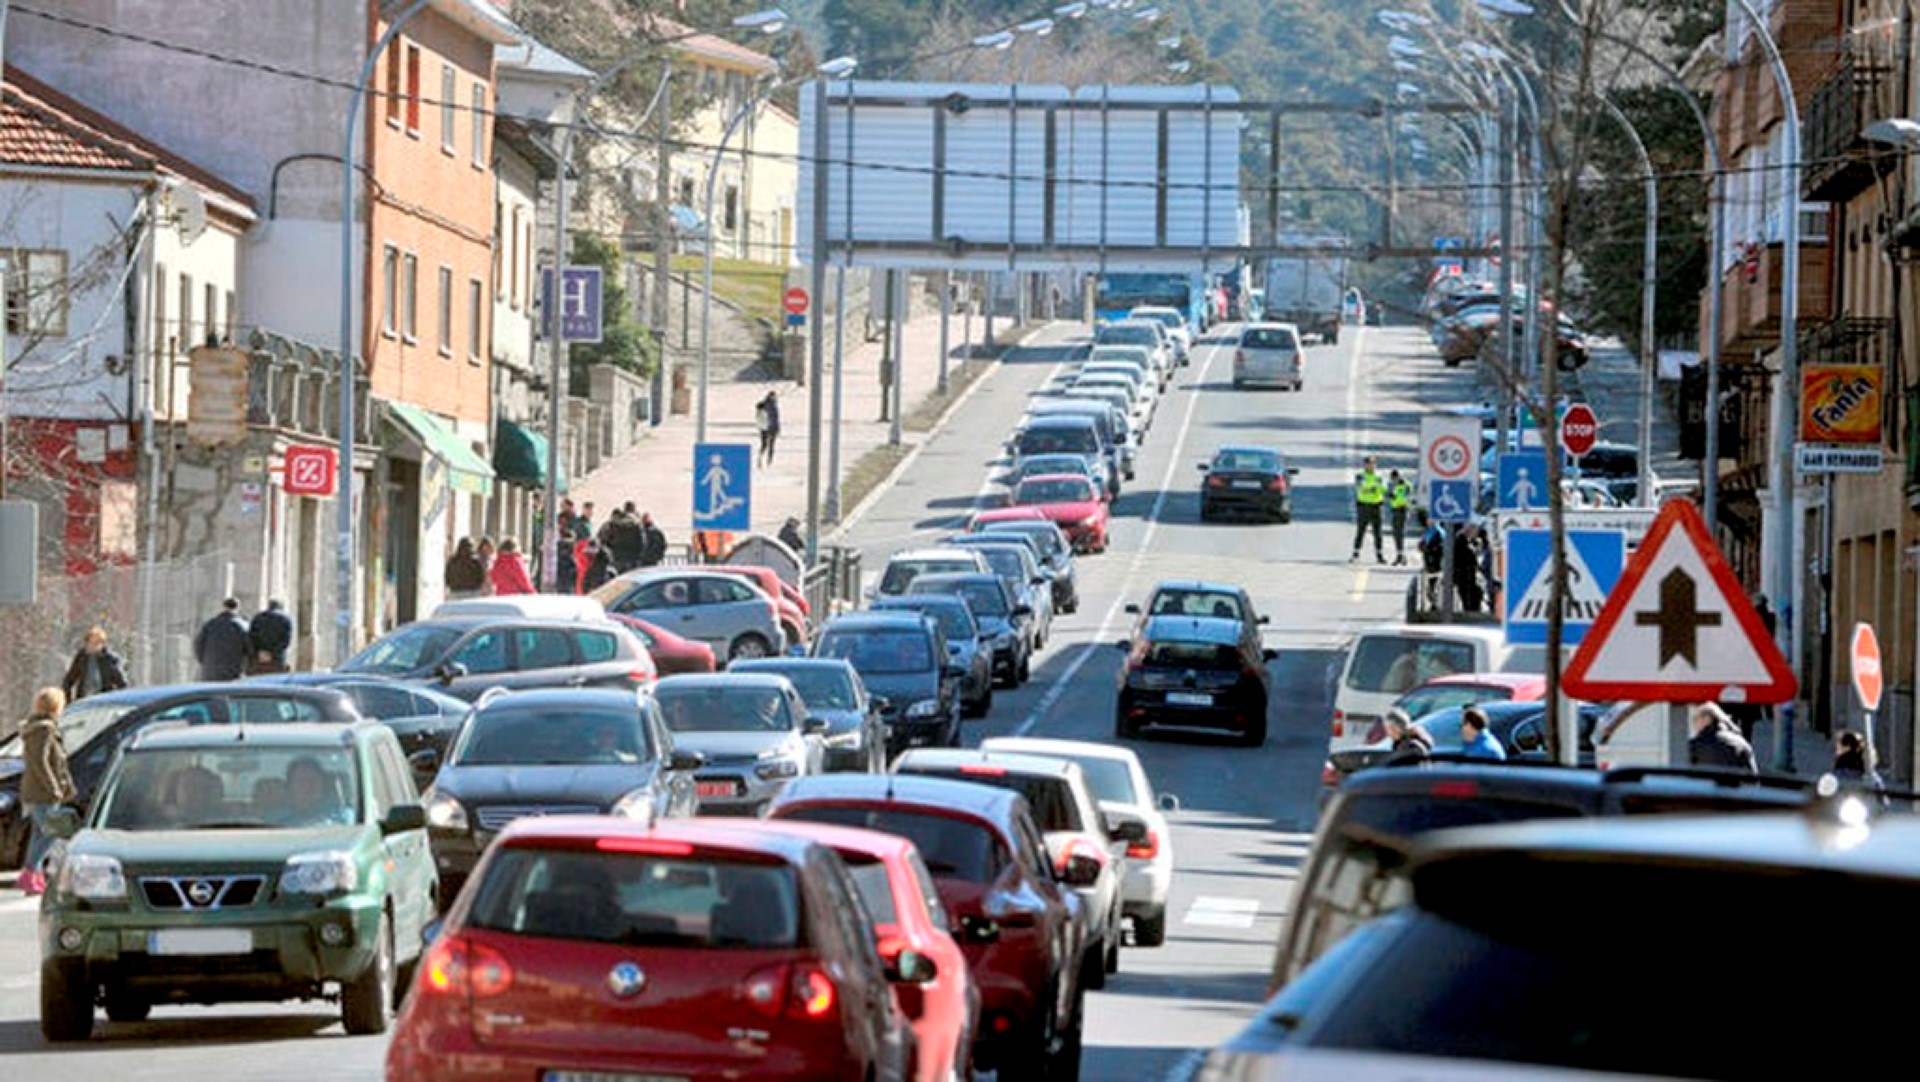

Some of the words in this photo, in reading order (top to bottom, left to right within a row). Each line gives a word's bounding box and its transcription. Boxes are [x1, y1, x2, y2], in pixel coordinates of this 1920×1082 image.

[560, 278, 589, 316] H
[1811, 376, 1874, 432] Fanta
[1566, 423, 1594, 437] STOP
[1438, 448, 1463, 464] 50
